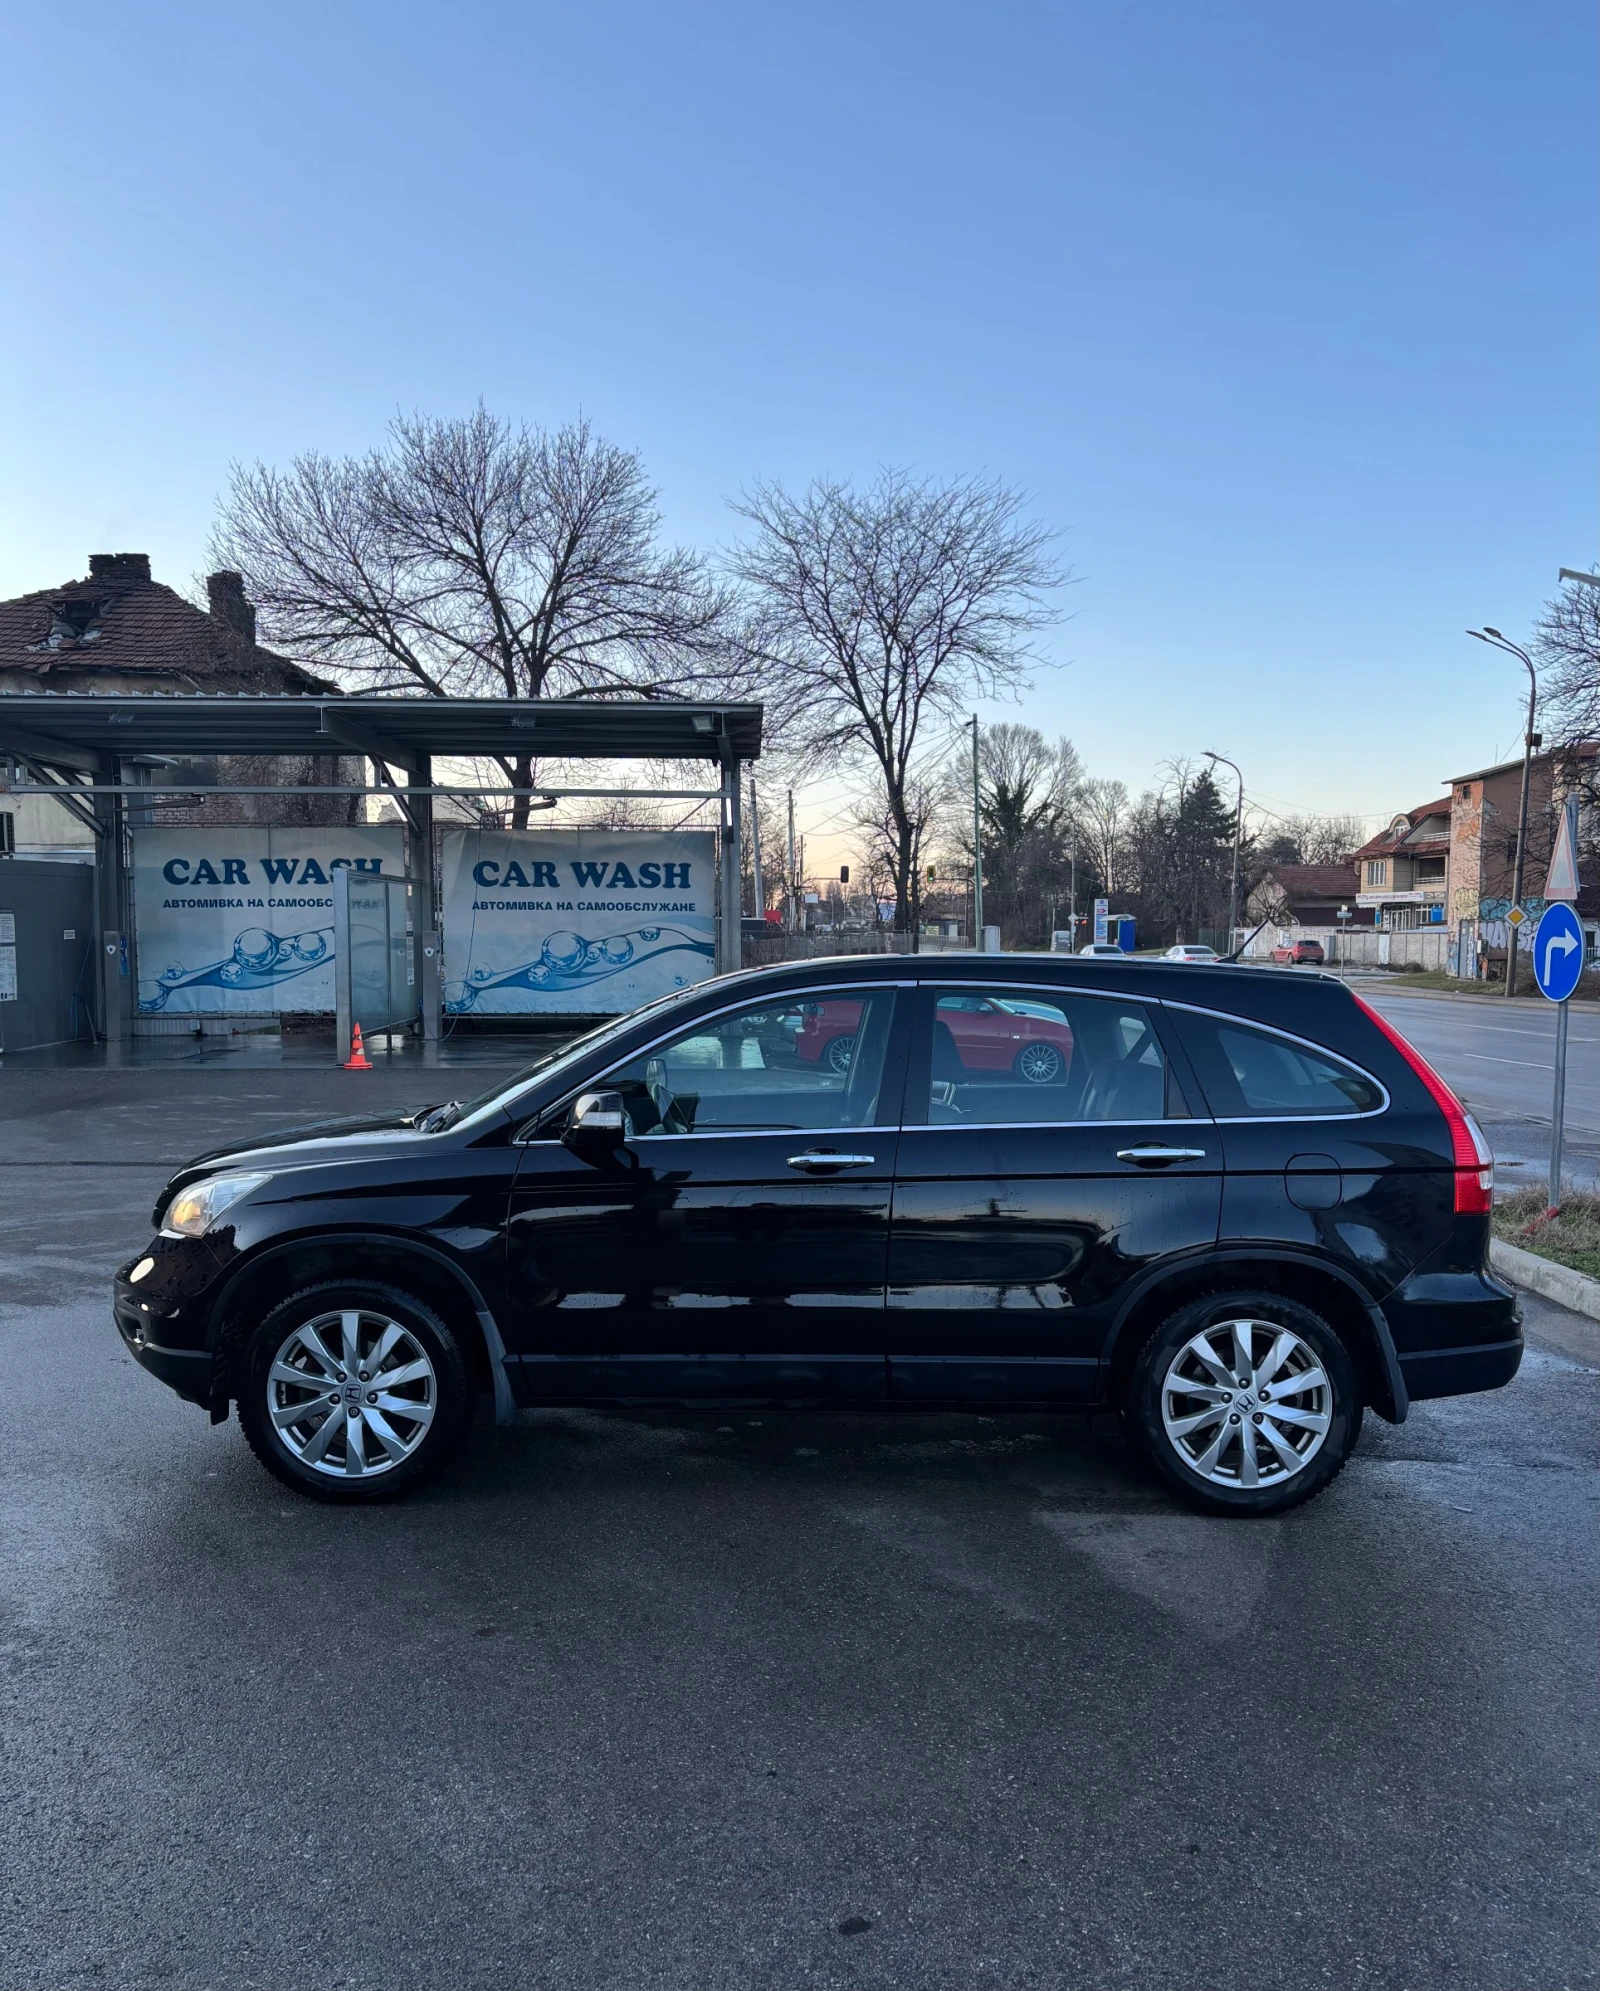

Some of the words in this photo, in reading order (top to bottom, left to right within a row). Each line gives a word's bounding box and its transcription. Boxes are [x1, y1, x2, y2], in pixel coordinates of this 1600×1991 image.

[162, 858, 251, 885] CAR
[472, 860, 561, 888] CAR
[570, 861, 693, 889] WASH
[163, 898, 244, 909] АВТОМИВКА
[247, 898, 264, 908] НА
[267, 898, 334, 909] САМООБС
[472, 901, 553, 911] АВТОМИВКА
[556, 901, 574, 911] НА
[577, 901, 696, 912] САМООБСЛУЖАНЕ
